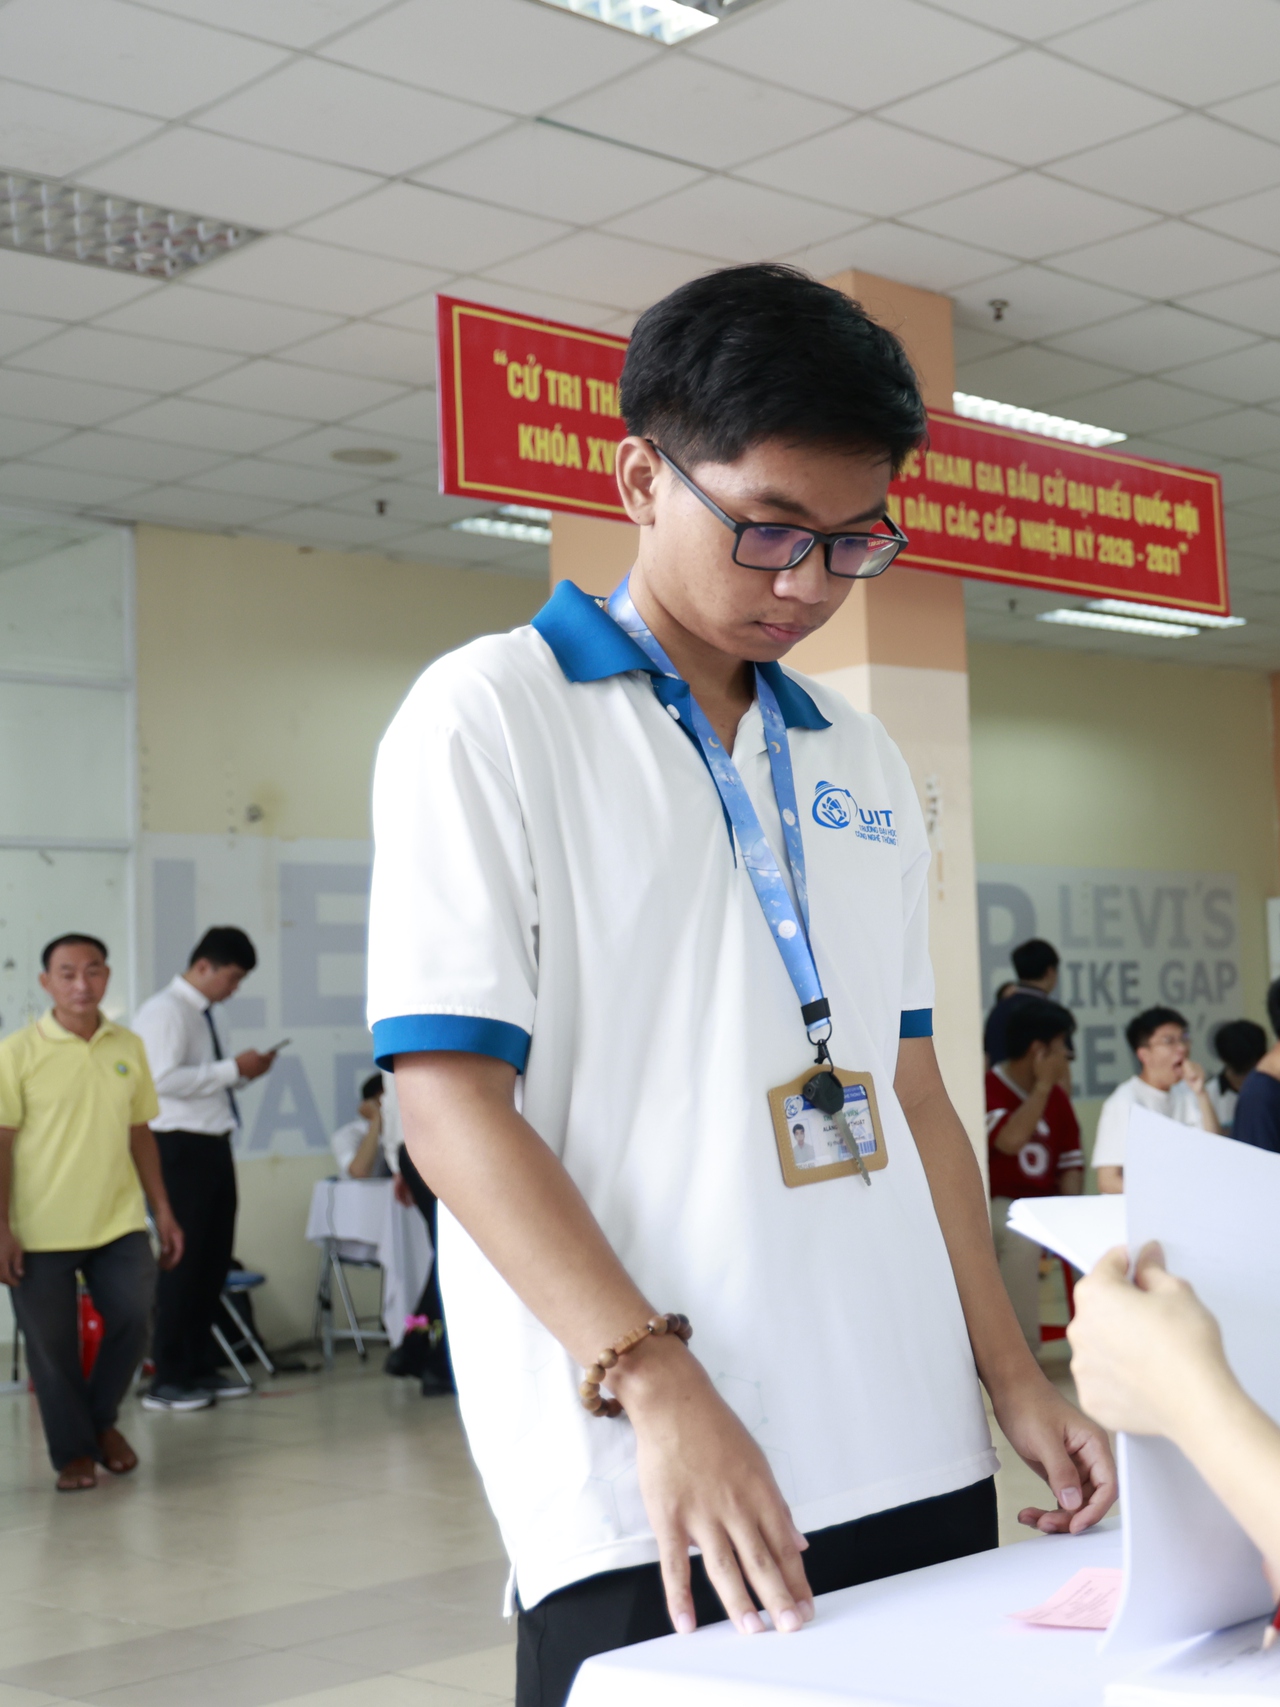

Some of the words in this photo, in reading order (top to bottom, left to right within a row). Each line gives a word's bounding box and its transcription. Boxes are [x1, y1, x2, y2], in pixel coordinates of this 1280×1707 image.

[493, 348, 542, 402] “CỬ
[544, 368, 582, 411] TRI
[586, 377, 622, 418] TH
[925, 450, 973, 489] THAM
[975, 460, 1005, 496] GIA
[1006, 461, 1040, 503] BẦU
[1042, 467, 1067, 508] CỬ
[1067, 480, 1095, 519] ĐẠI
[1096, 479, 1131, 521] BIỂU
[1133, 489, 1173, 530] QUỐC
[1173, 499, 1200, 539] HỘI
[518, 422, 583, 470] KHÓA
[904, 493, 943, 534] DÂN
[945, 501, 981, 541] CÁC
[982, 505, 1017, 547] CẤP
[1020, 517, 1072, 560] NHIỆM
[1074, 525, 1095, 559] KỲ
[858, 808, 893, 828] UIT
[1057, 880, 1238, 951] LEVI'S
[1055, 959, 1141, 1010] IKE
[1159, 959, 1239, 1006] GAP
